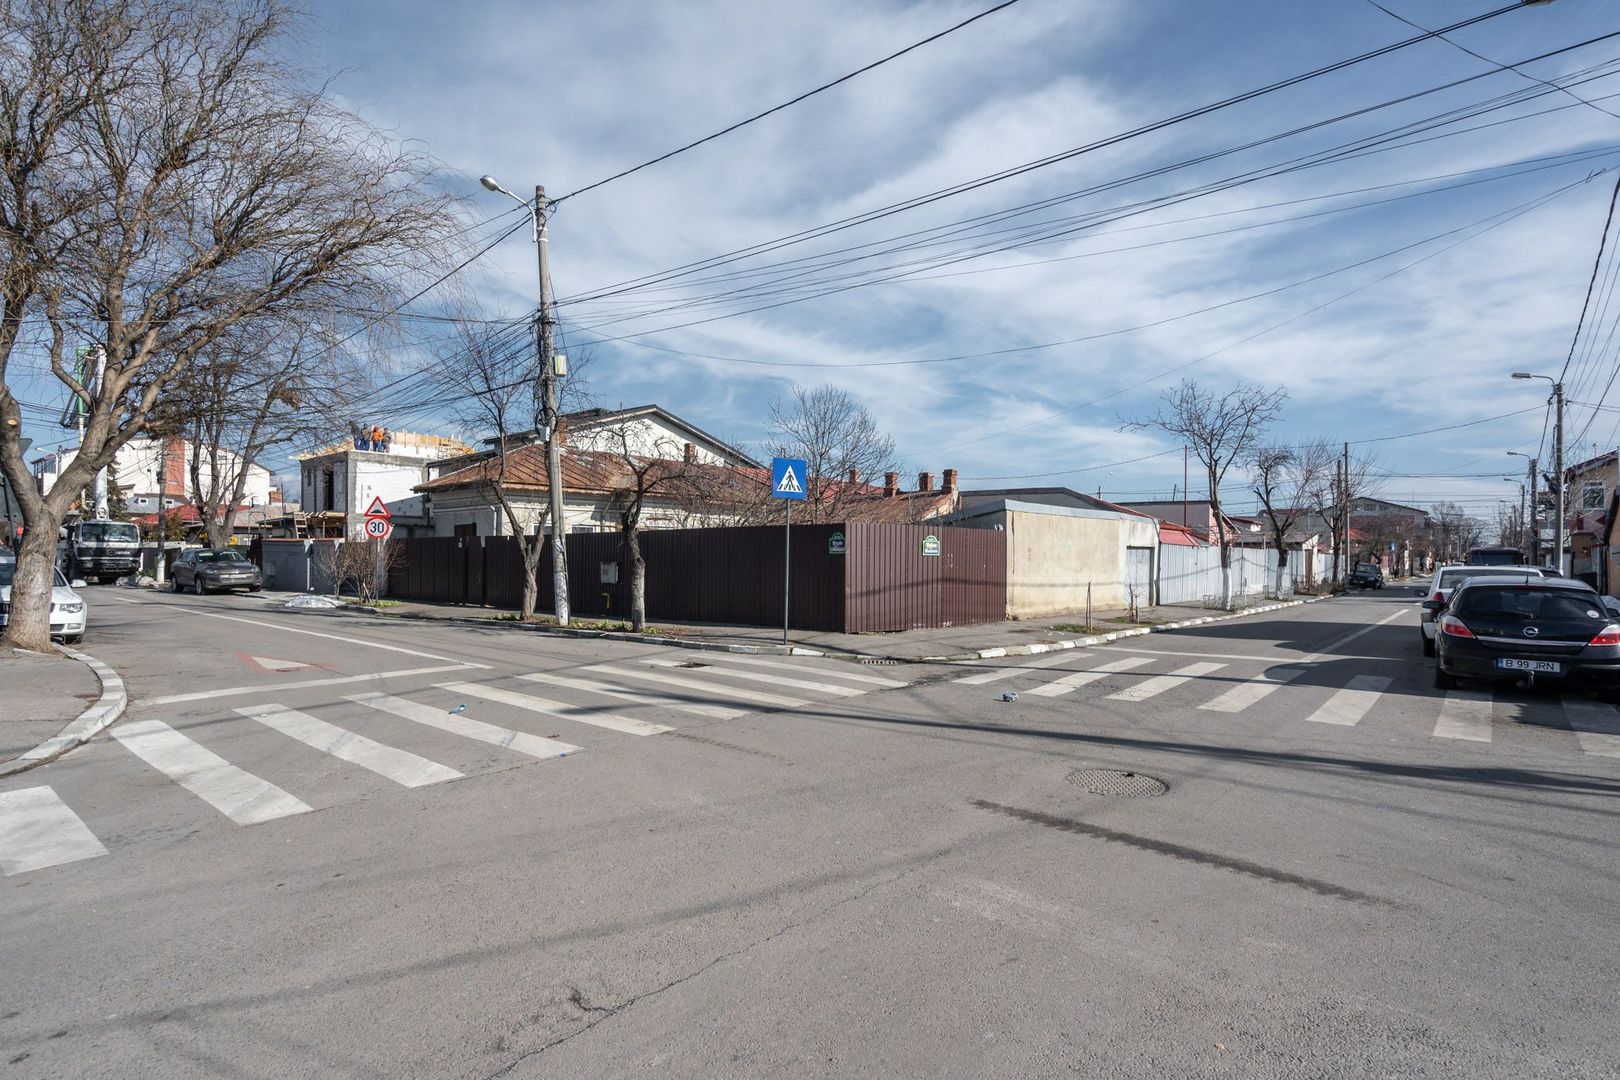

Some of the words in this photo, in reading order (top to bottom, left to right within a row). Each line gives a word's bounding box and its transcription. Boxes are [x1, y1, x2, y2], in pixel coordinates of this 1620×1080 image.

[370, 522, 384, 533] 30
[1516, 660, 1529, 668] 99
[1534, 662, 1554, 670] JRN
